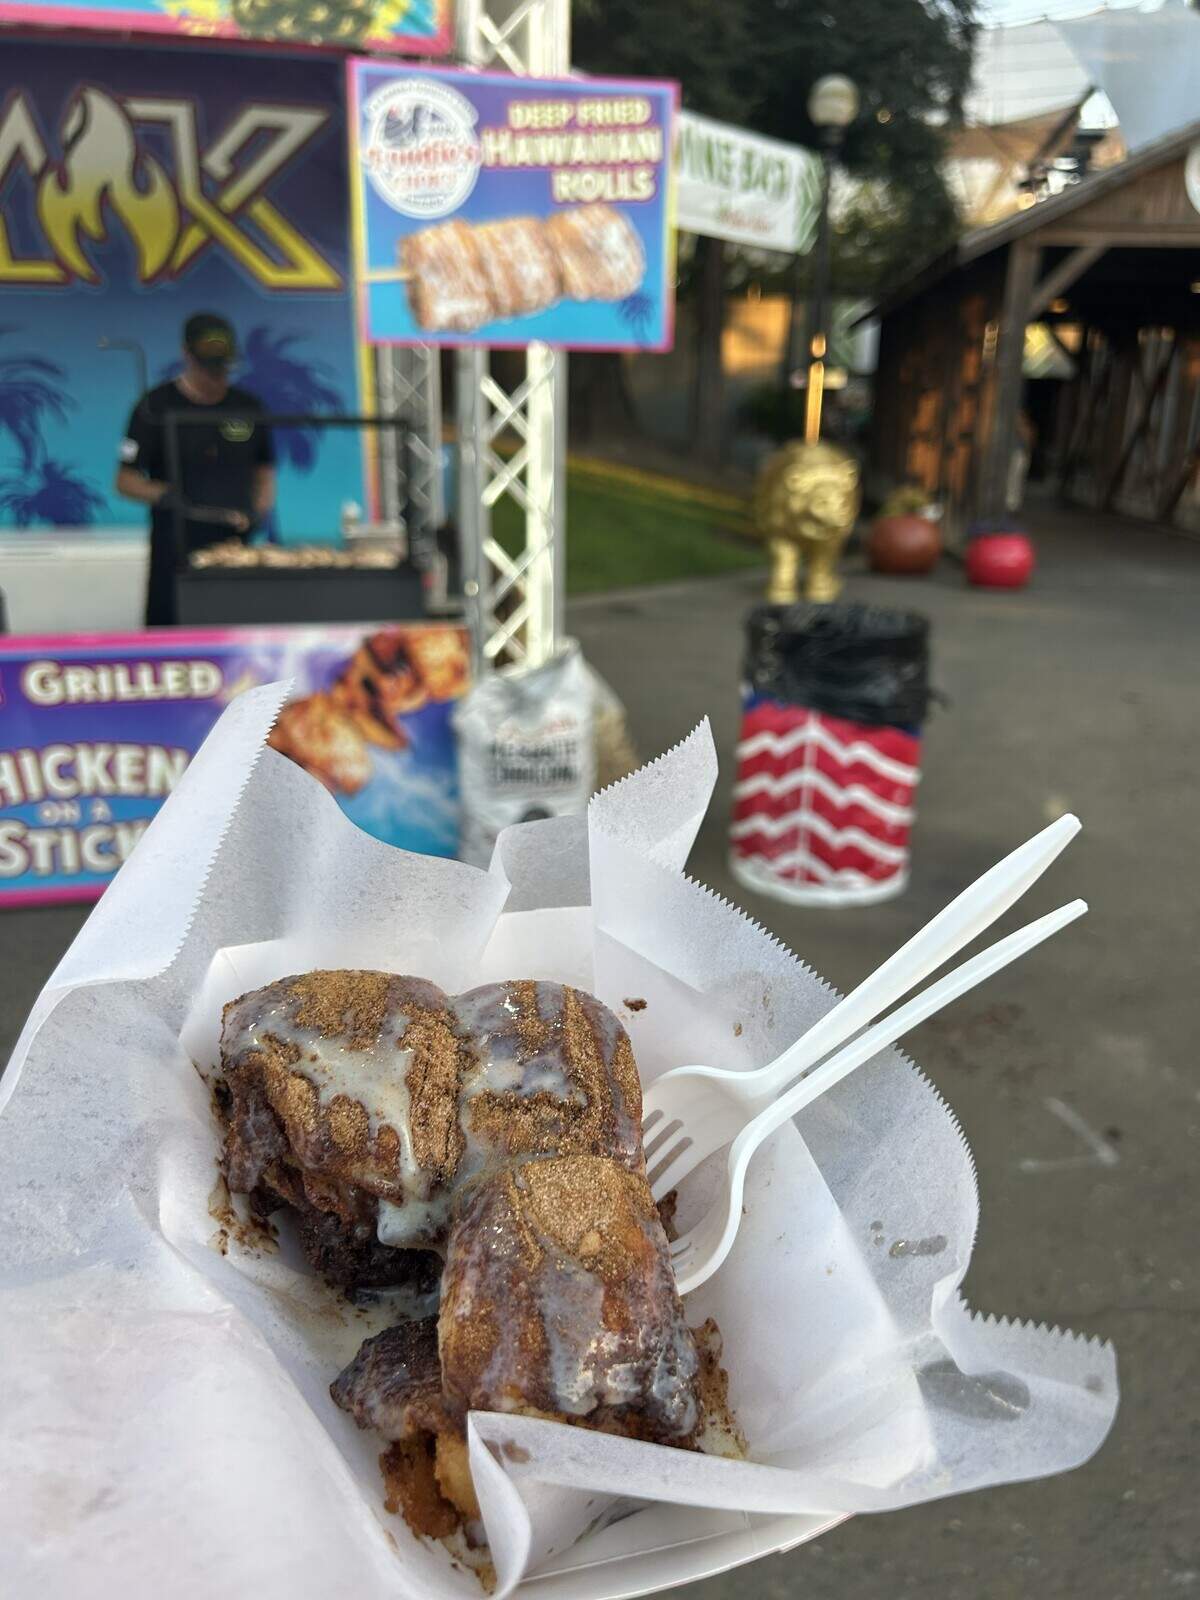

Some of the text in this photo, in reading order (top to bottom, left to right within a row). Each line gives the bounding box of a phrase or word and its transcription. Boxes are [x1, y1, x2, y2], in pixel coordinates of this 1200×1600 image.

[510, 97, 651, 129] DEEP FRIED
[481, 129, 663, 167] HAWAIIAN
[553, 167, 656, 203] ROLLS
[24, 660, 222, 705] GRILLED
[38, 799, 112, 825] ON A
